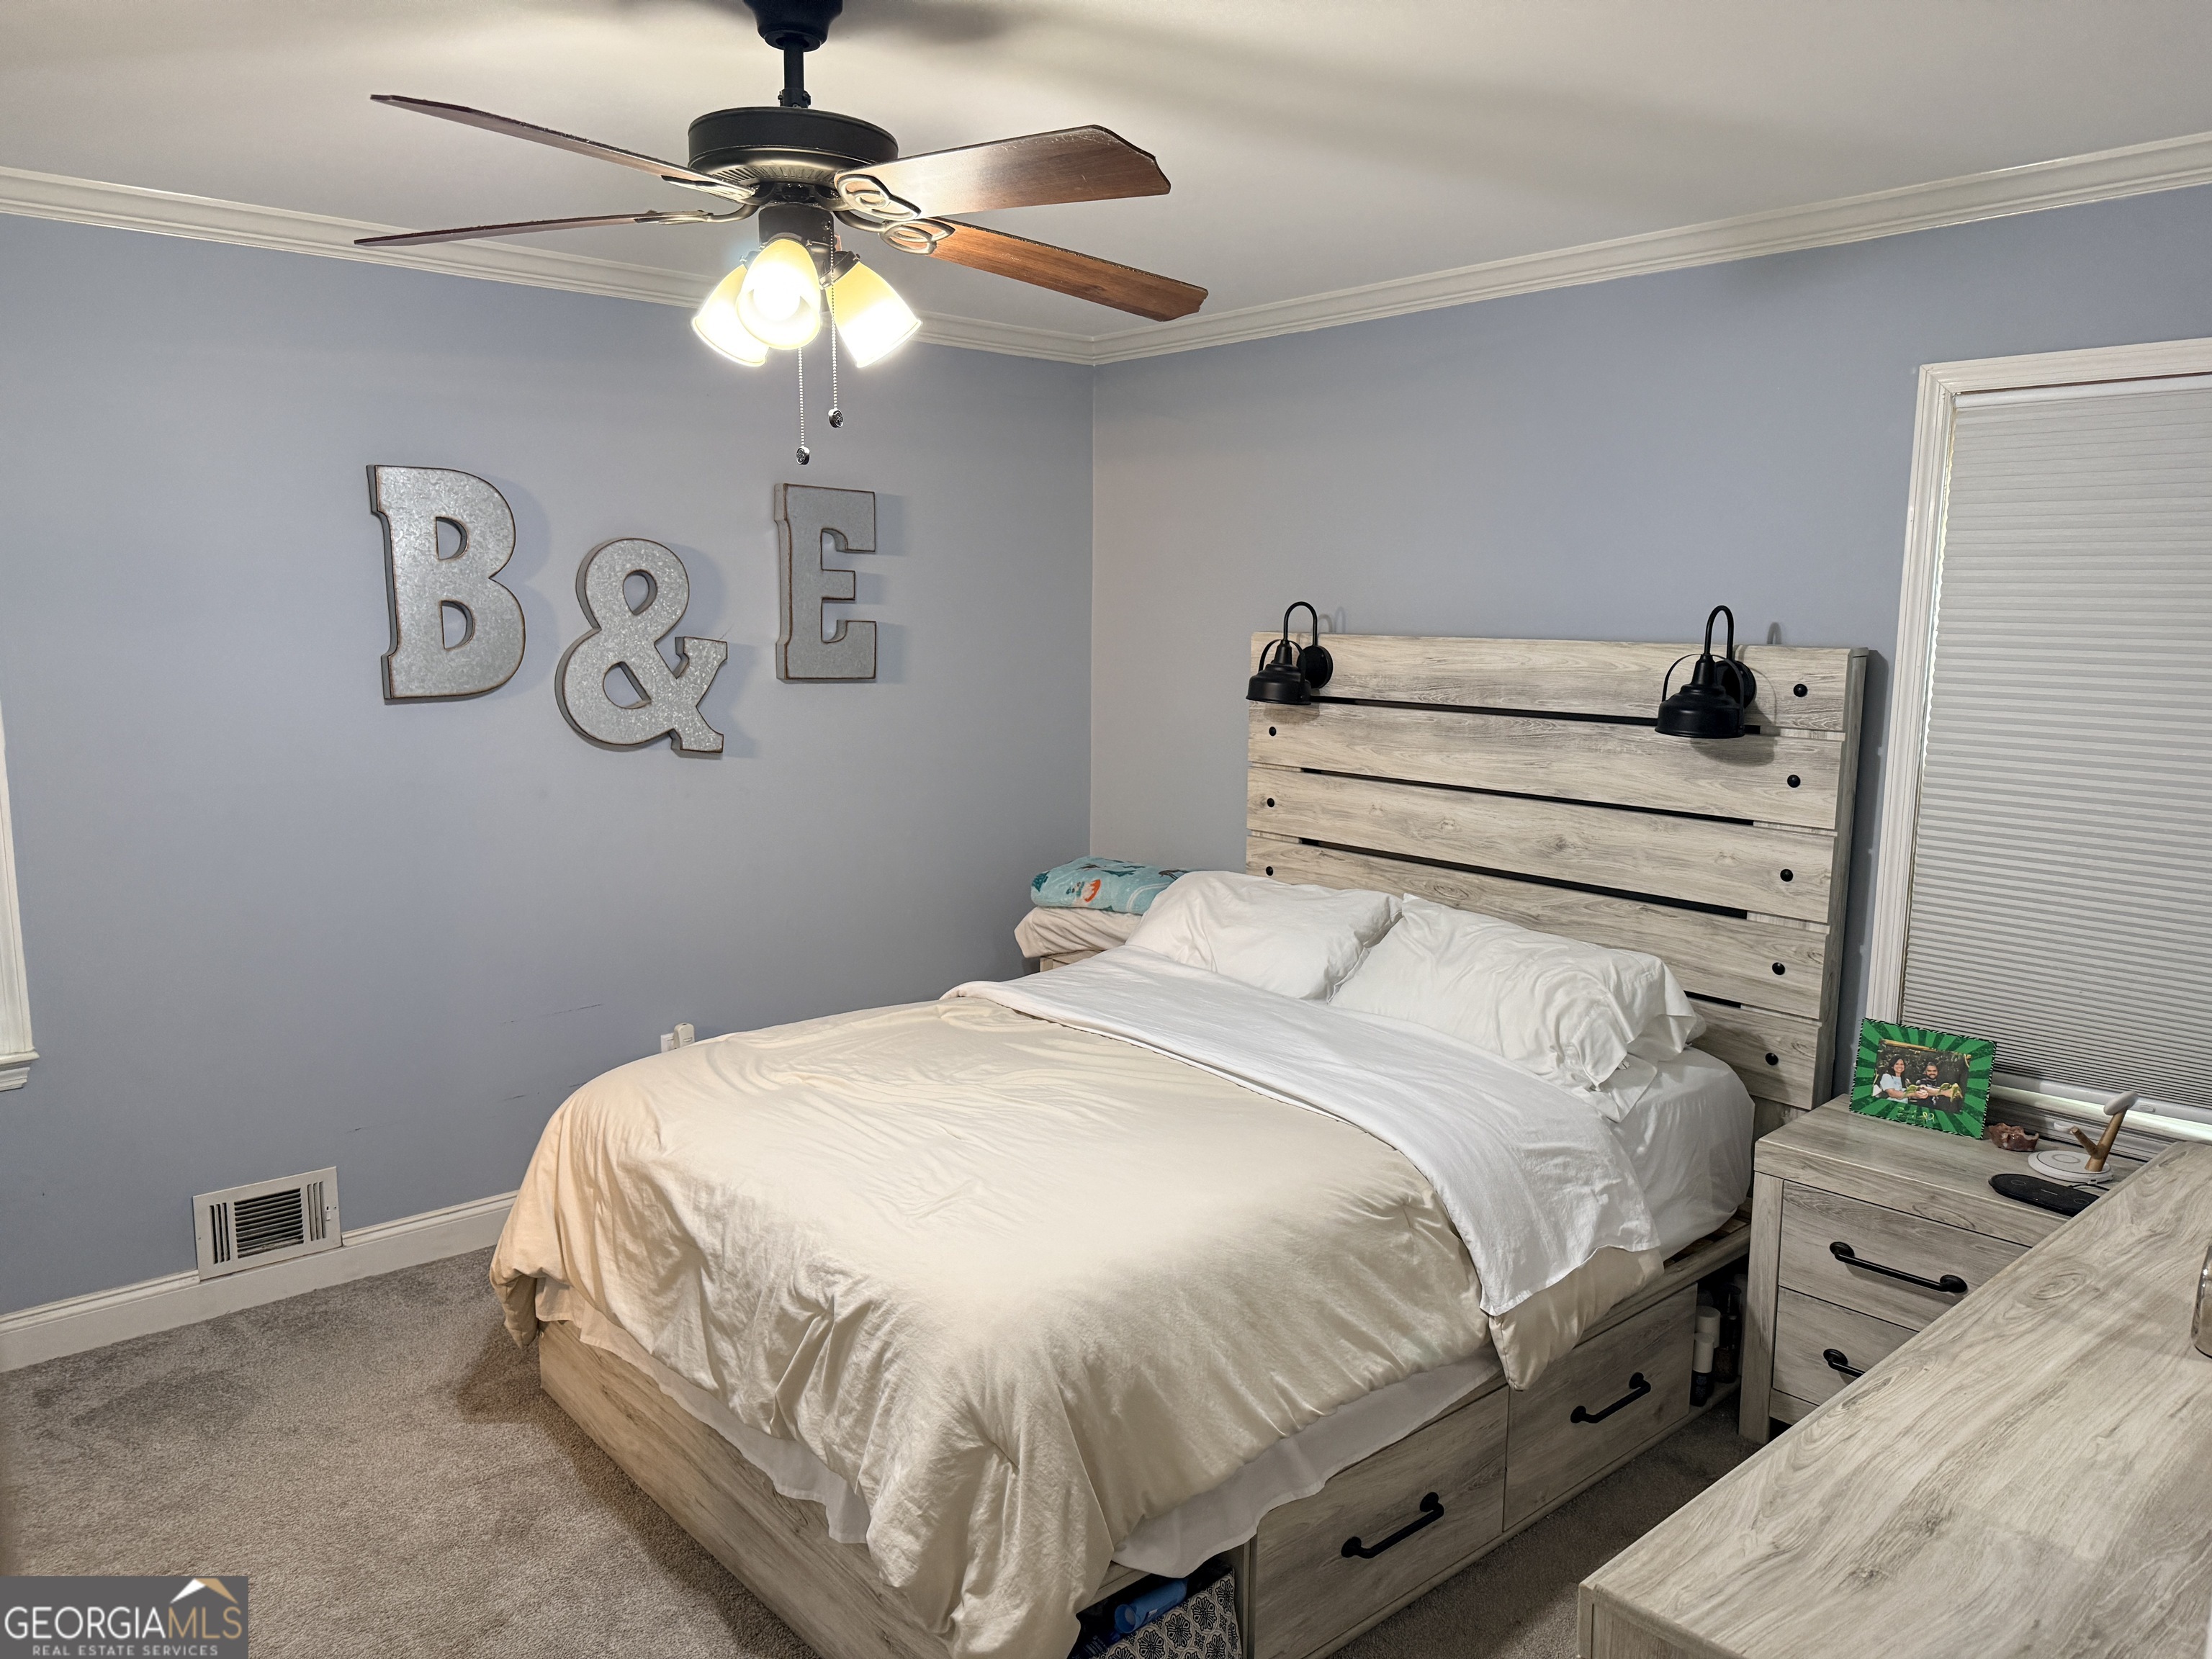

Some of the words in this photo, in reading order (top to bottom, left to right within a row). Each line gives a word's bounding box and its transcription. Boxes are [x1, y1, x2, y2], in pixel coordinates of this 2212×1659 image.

[367, 464, 526, 704] B
[555, 538, 727, 753] &
[774, 483, 876, 684] E
